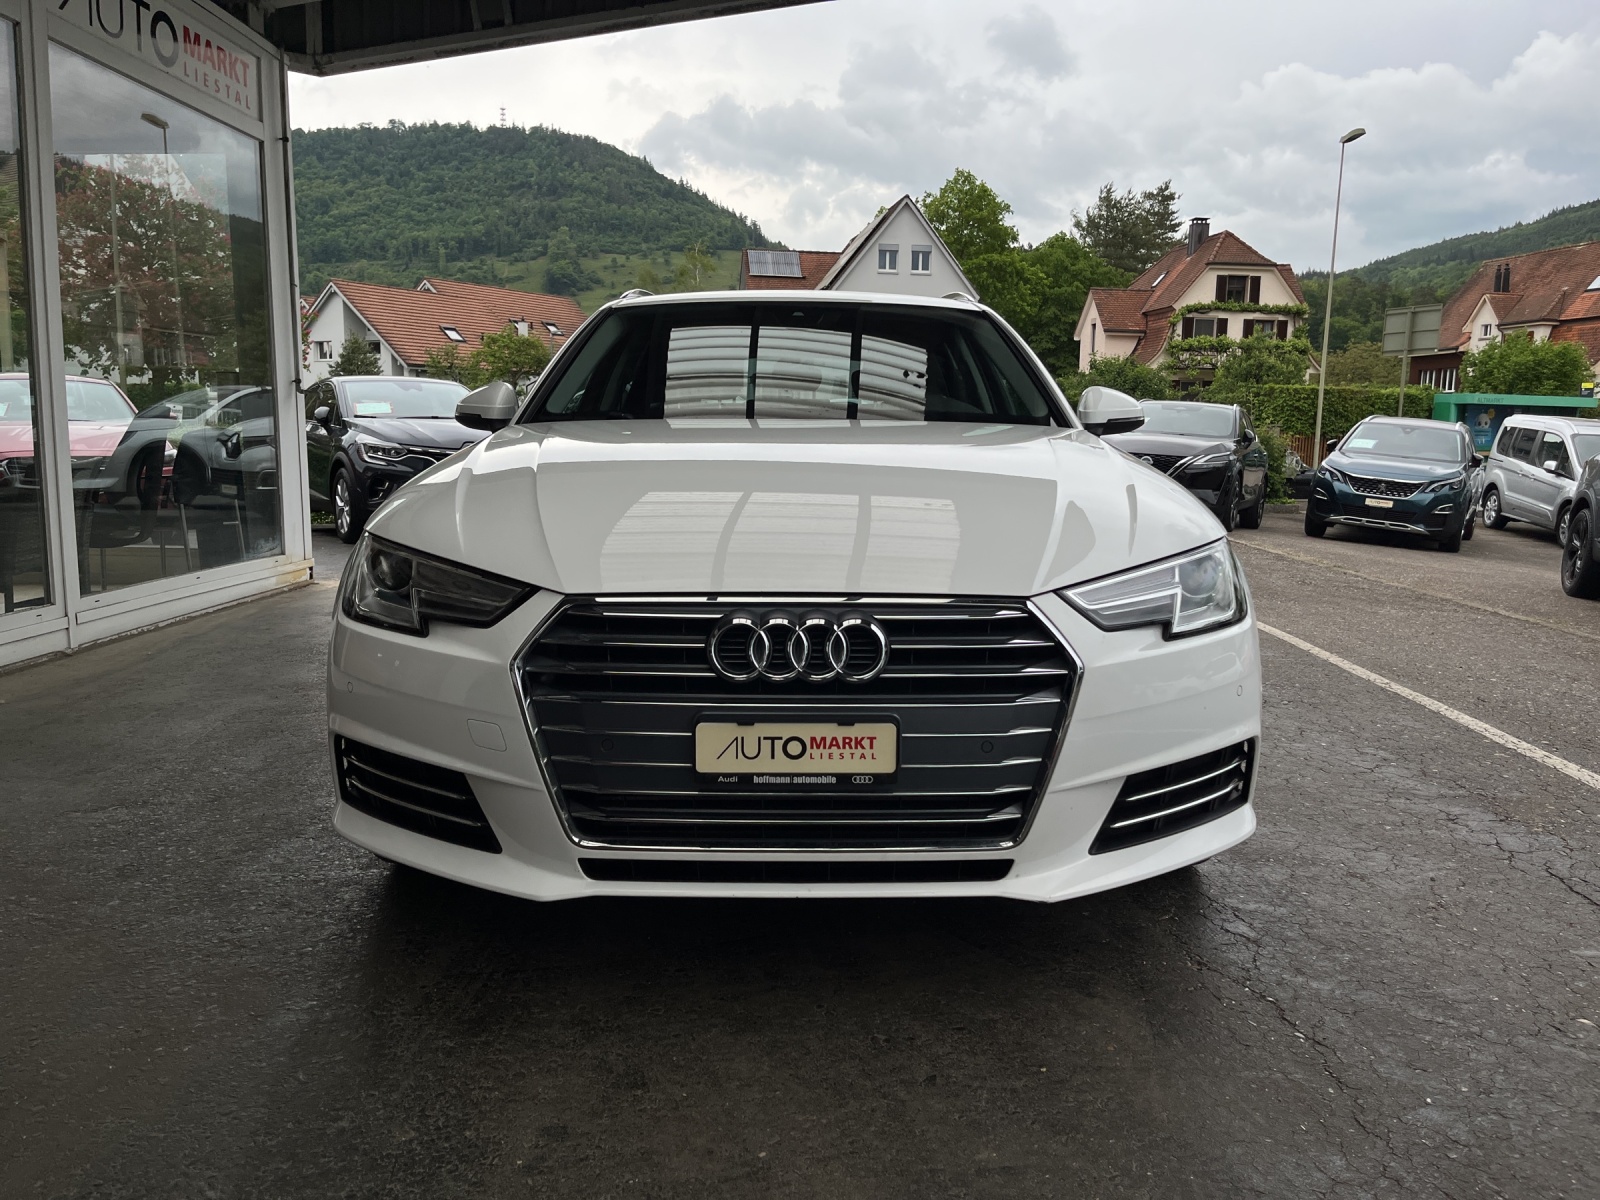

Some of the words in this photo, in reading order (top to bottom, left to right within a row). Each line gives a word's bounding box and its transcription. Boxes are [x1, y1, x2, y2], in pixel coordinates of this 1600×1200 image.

[183, 25, 250, 88] MARKT
[184, 61, 251, 110] LIESTAL
[716, 736, 808, 760] AUTO
[809, 736, 877, 750] MARKT
[809, 752, 877, 760] LIESTAL
[717, 775, 738, 783] Audi
[753, 775, 791, 784] hoffmann
[792, 775, 837, 784] automobile
